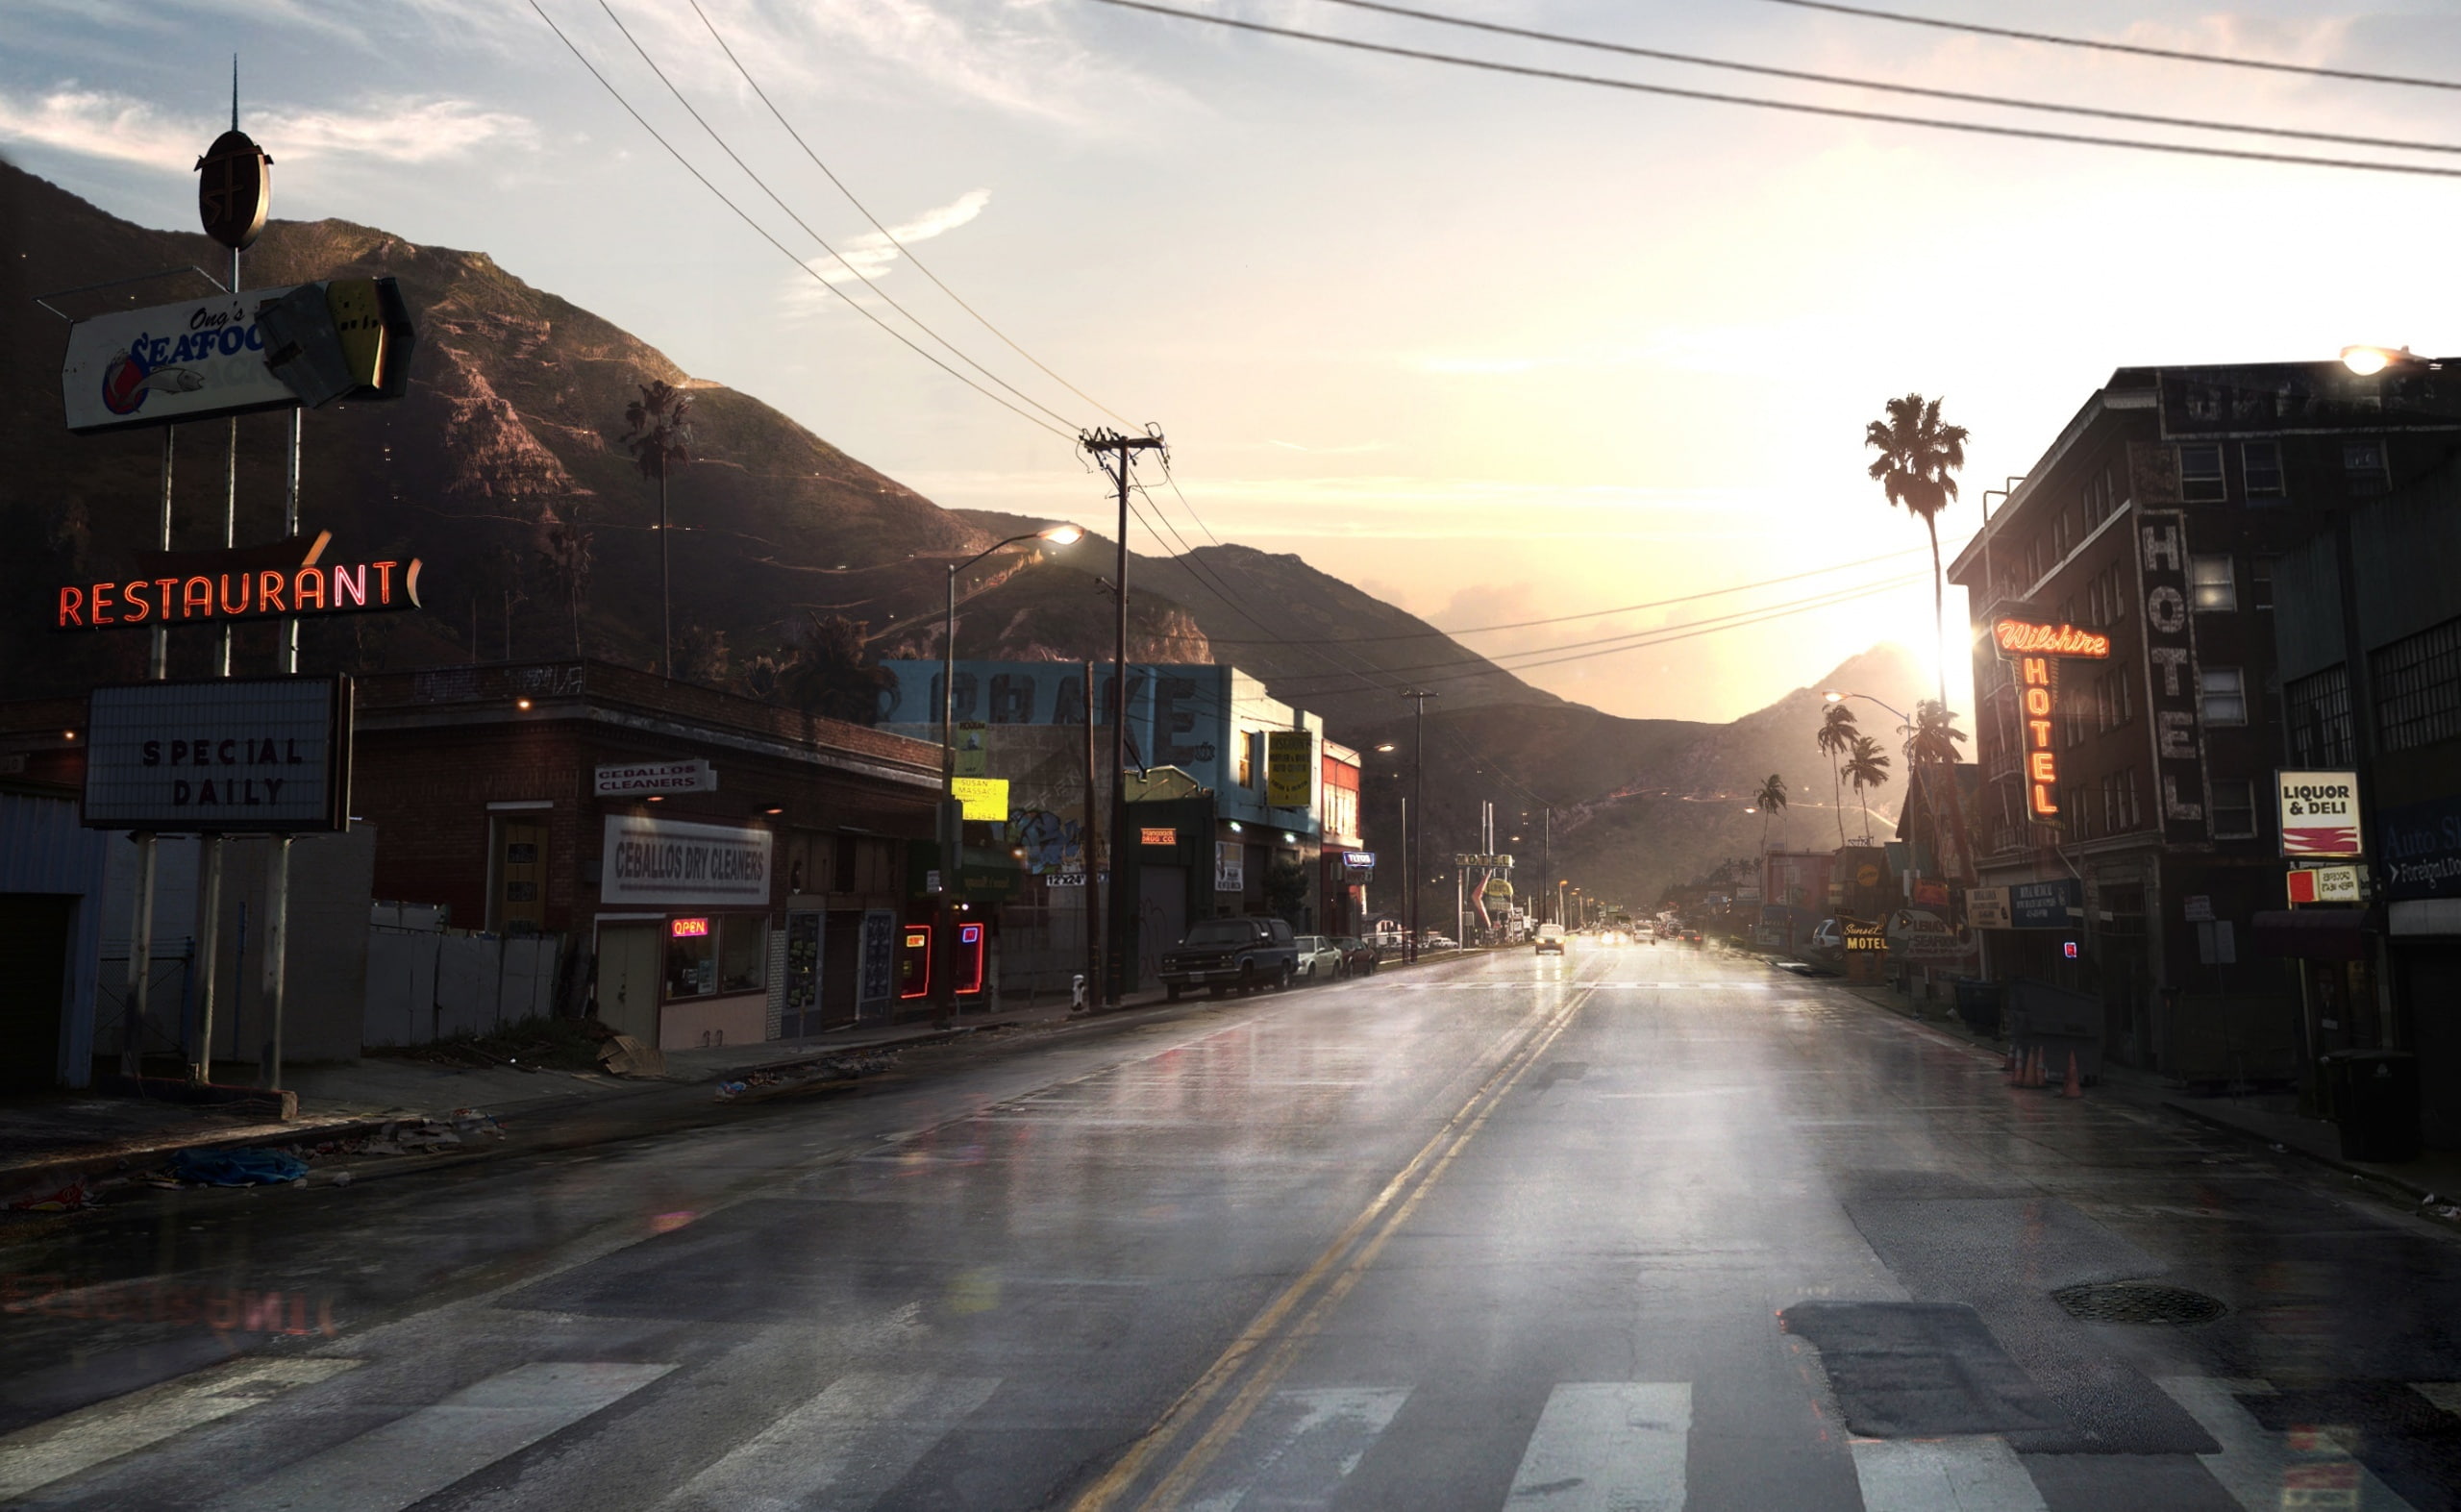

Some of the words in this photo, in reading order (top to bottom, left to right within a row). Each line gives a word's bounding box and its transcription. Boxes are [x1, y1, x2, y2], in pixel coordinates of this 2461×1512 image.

[189, 300, 245, 331] Ong's
[130, 323, 265, 367] SEAFOO
[1997, 622, 2106, 655] Wilshire
[2142, 525, 2202, 820] HOTEL
[2024, 657, 2058, 813] HOTEL
[142, 738, 302, 766] SPECIAL
[598, 764, 696, 780] CEBALLOS
[599, 777, 696, 791] CLEANERS
[960, 779, 989, 787] SUSAN
[173, 778, 284, 806] DAILY
[2283, 785, 2349, 802] LIQUOR
[2290, 801, 2303, 815] &
[2308, 802, 2347, 815] DELI
[2384, 823, 2437, 859] Auto
[615, 841, 683, 879] CEBALLOS
[684, 847, 709, 880] DRY
[710, 848, 764, 882] CLEANERS
[673, 921, 706, 935] OPEN
[1843, 922, 1884, 937] Sunset
[1847, 937, 1890, 951] MOTEL
